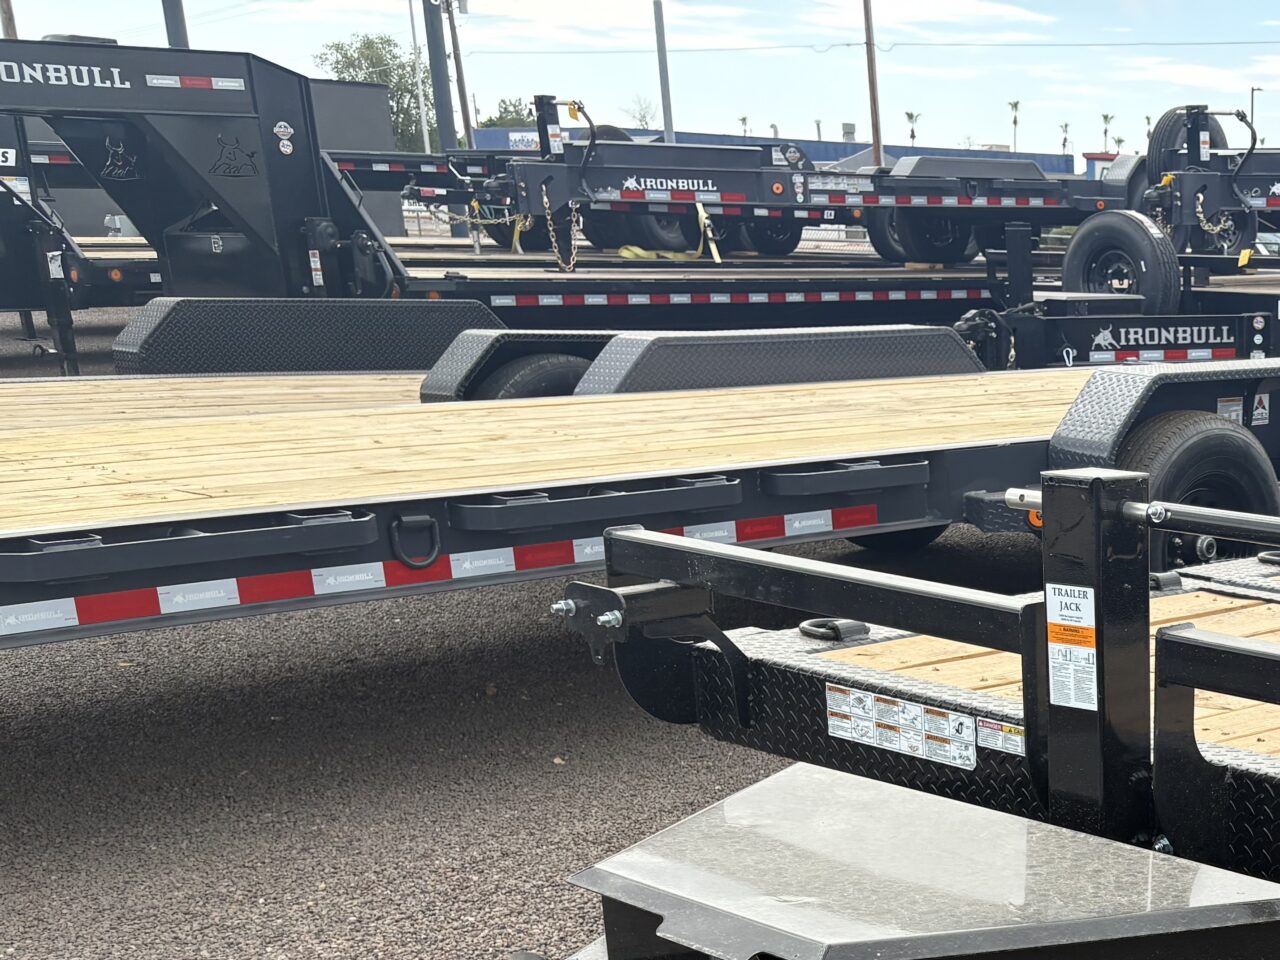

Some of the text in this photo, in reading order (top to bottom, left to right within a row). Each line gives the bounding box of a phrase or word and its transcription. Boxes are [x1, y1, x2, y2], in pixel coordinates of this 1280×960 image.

[640, 178, 718, 191] IRONBULL
[1119, 326, 1235, 345] IRONBULL
[1051, 587, 1088, 600] TRAILER
[1060, 601, 1081, 612] JACK
